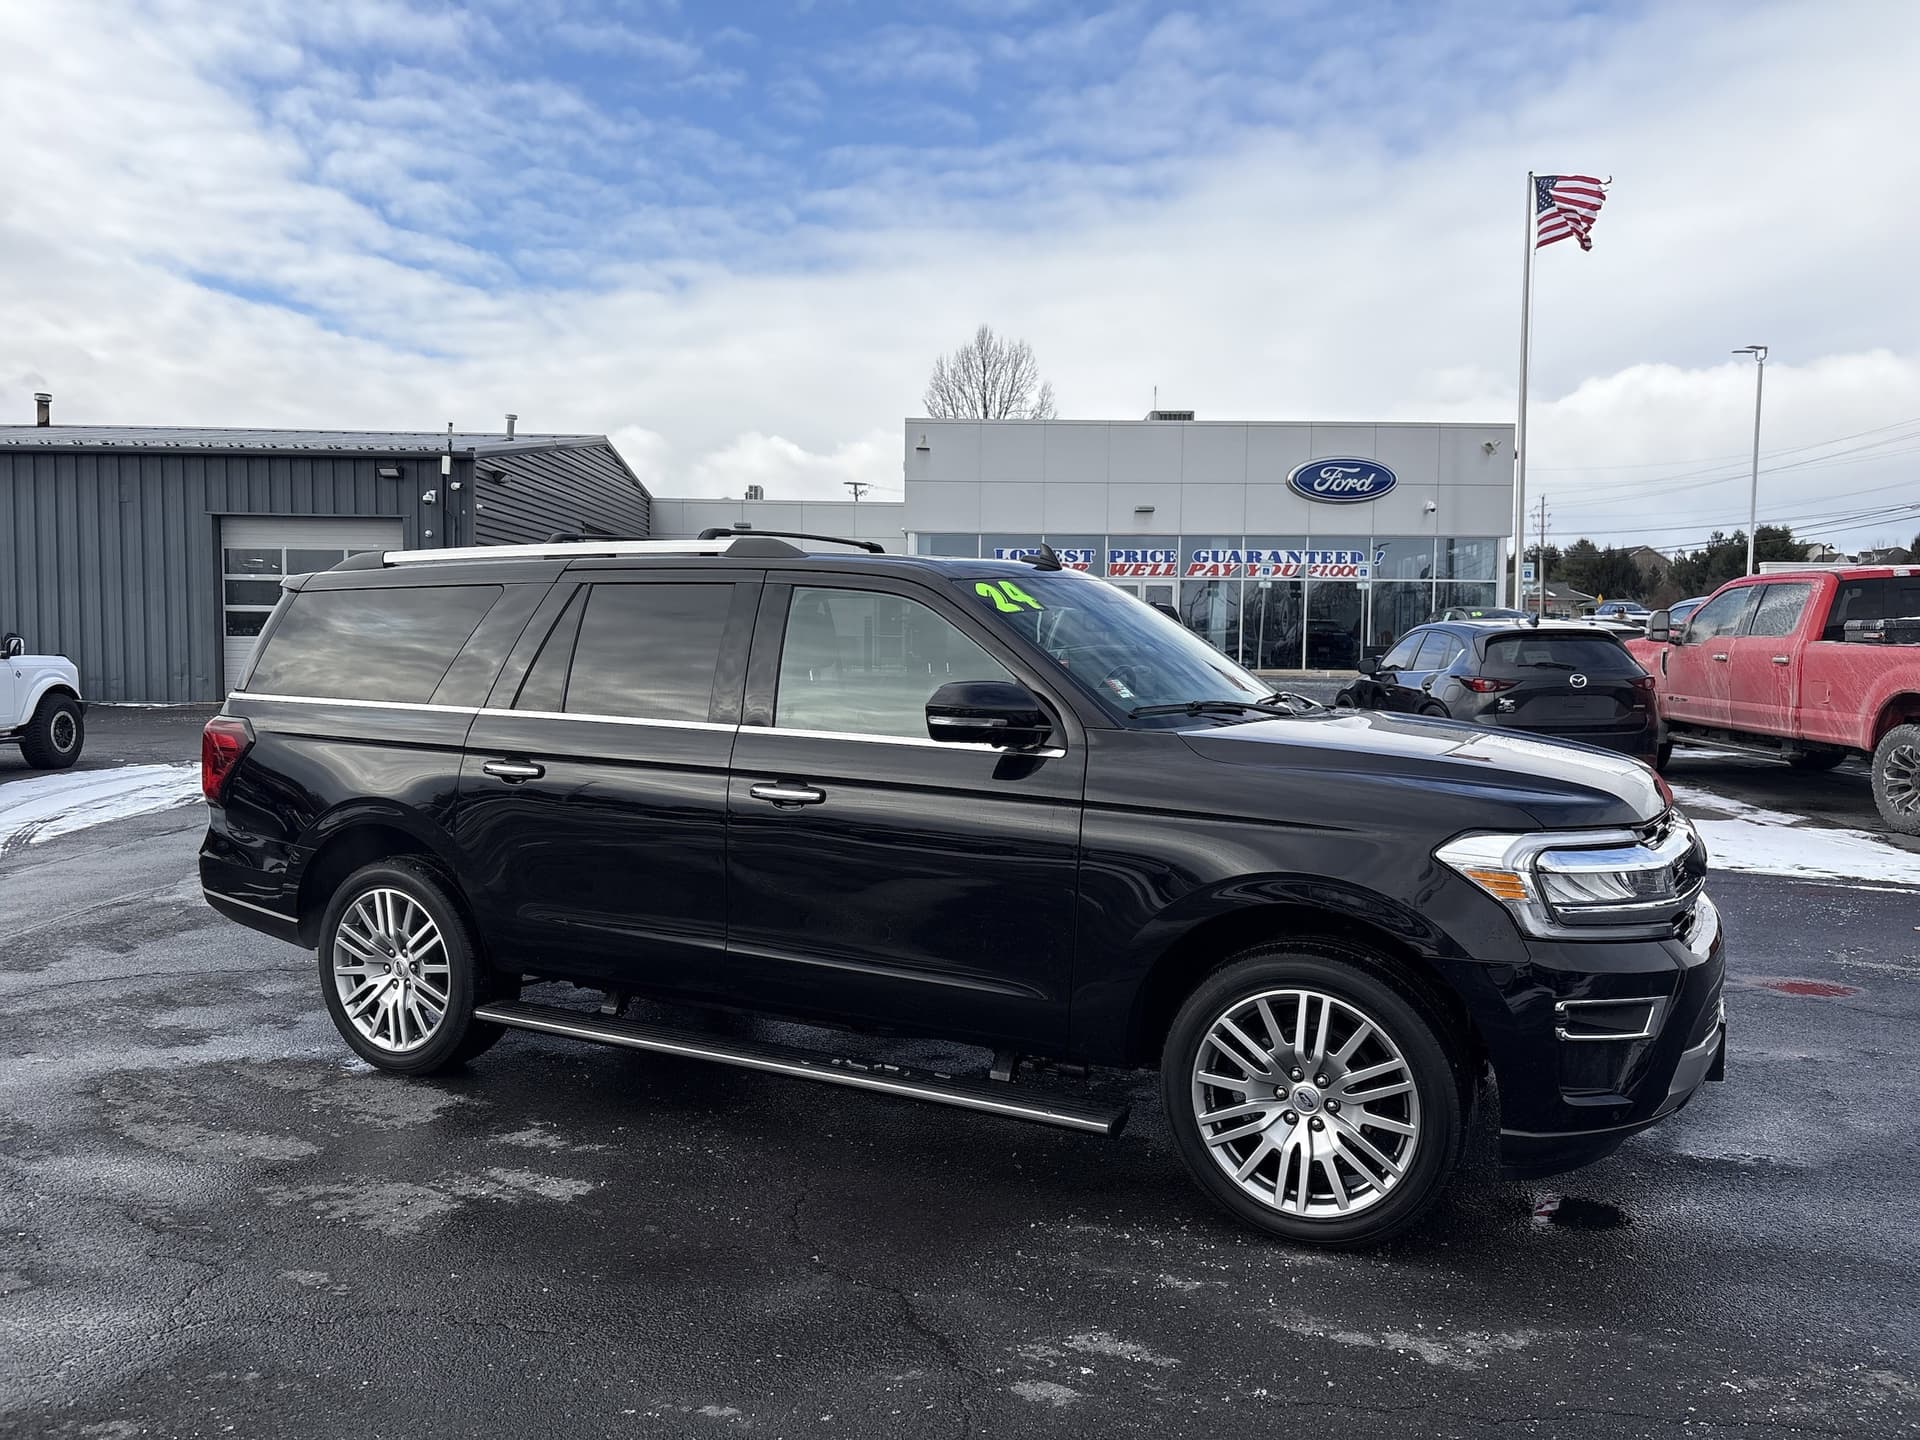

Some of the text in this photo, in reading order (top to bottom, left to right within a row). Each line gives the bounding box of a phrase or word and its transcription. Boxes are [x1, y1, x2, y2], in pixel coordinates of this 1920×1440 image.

[1313, 466, 1376, 492] Ford
[1109, 550, 1176, 563] PRICE
[1187, 563, 1240, 577] PAY
[975, 581, 1044, 613] 24
